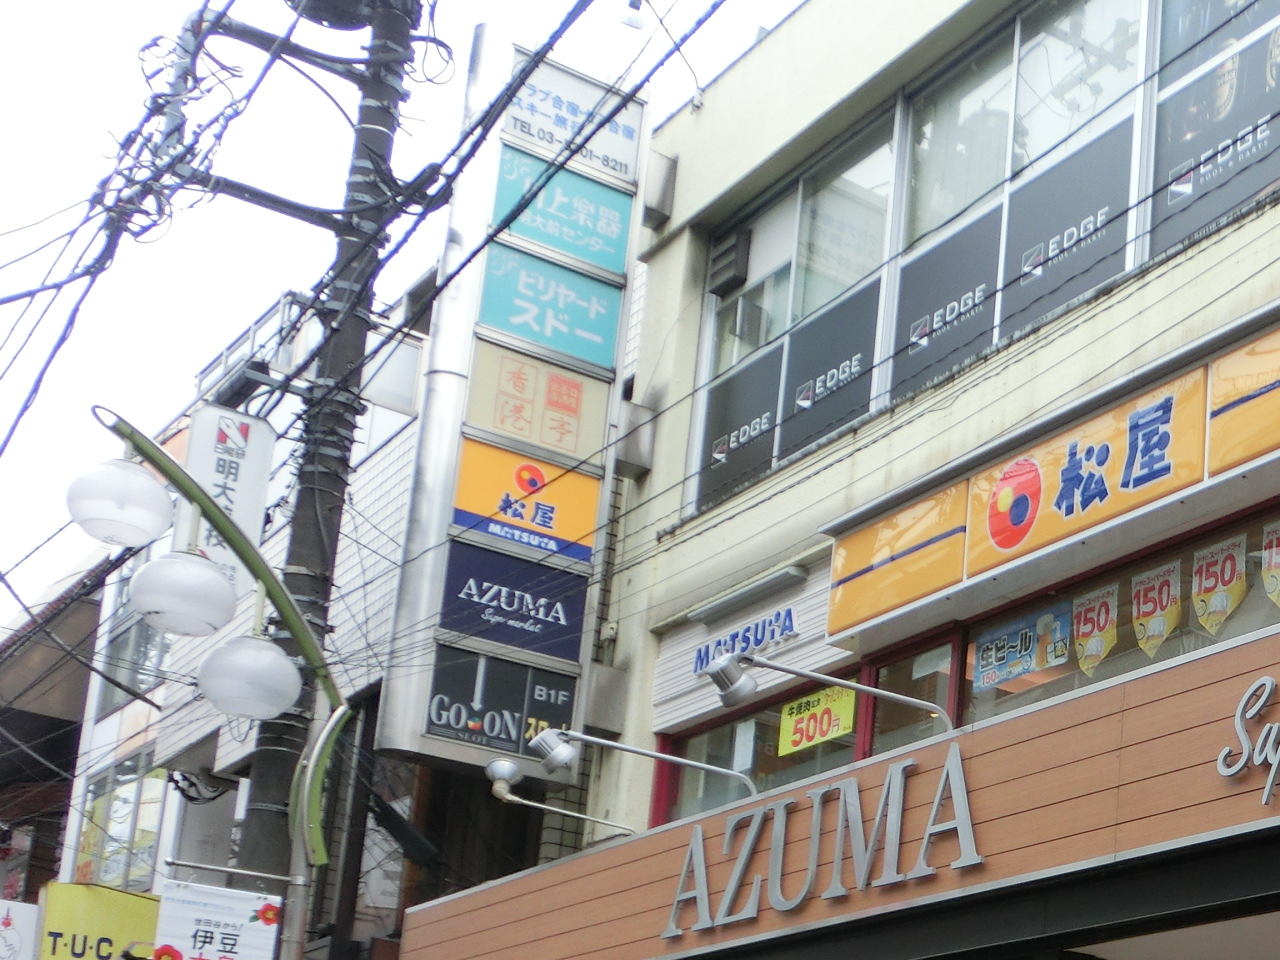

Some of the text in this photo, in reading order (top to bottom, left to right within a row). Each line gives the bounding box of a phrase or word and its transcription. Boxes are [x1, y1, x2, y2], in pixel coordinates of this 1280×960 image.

[511, 116, 534, 137] TEL
[1200, 114, 1271, 174] EDGE
[1048, 206, 1109, 257] EDGE
[518, 268, 608, 320] ビリヤード
[933, 283, 986, 330] EDGE
[509, 298, 604, 343] スドー
[815, 353, 862, 393] EDGE
[730, 412, 770, 449] EDGE
[1053, 395, 1176, 518] 松屋
[497, 493, 555, 530] 松屋
[488, 522, 558, 551] MATSUYA
[457, 577, 568, 626] AZUMA
[533, 684, 570, 705] B1F
[660, 743, 983, 940] AZUMA
[190, 929, 240, 954] 伊豆
